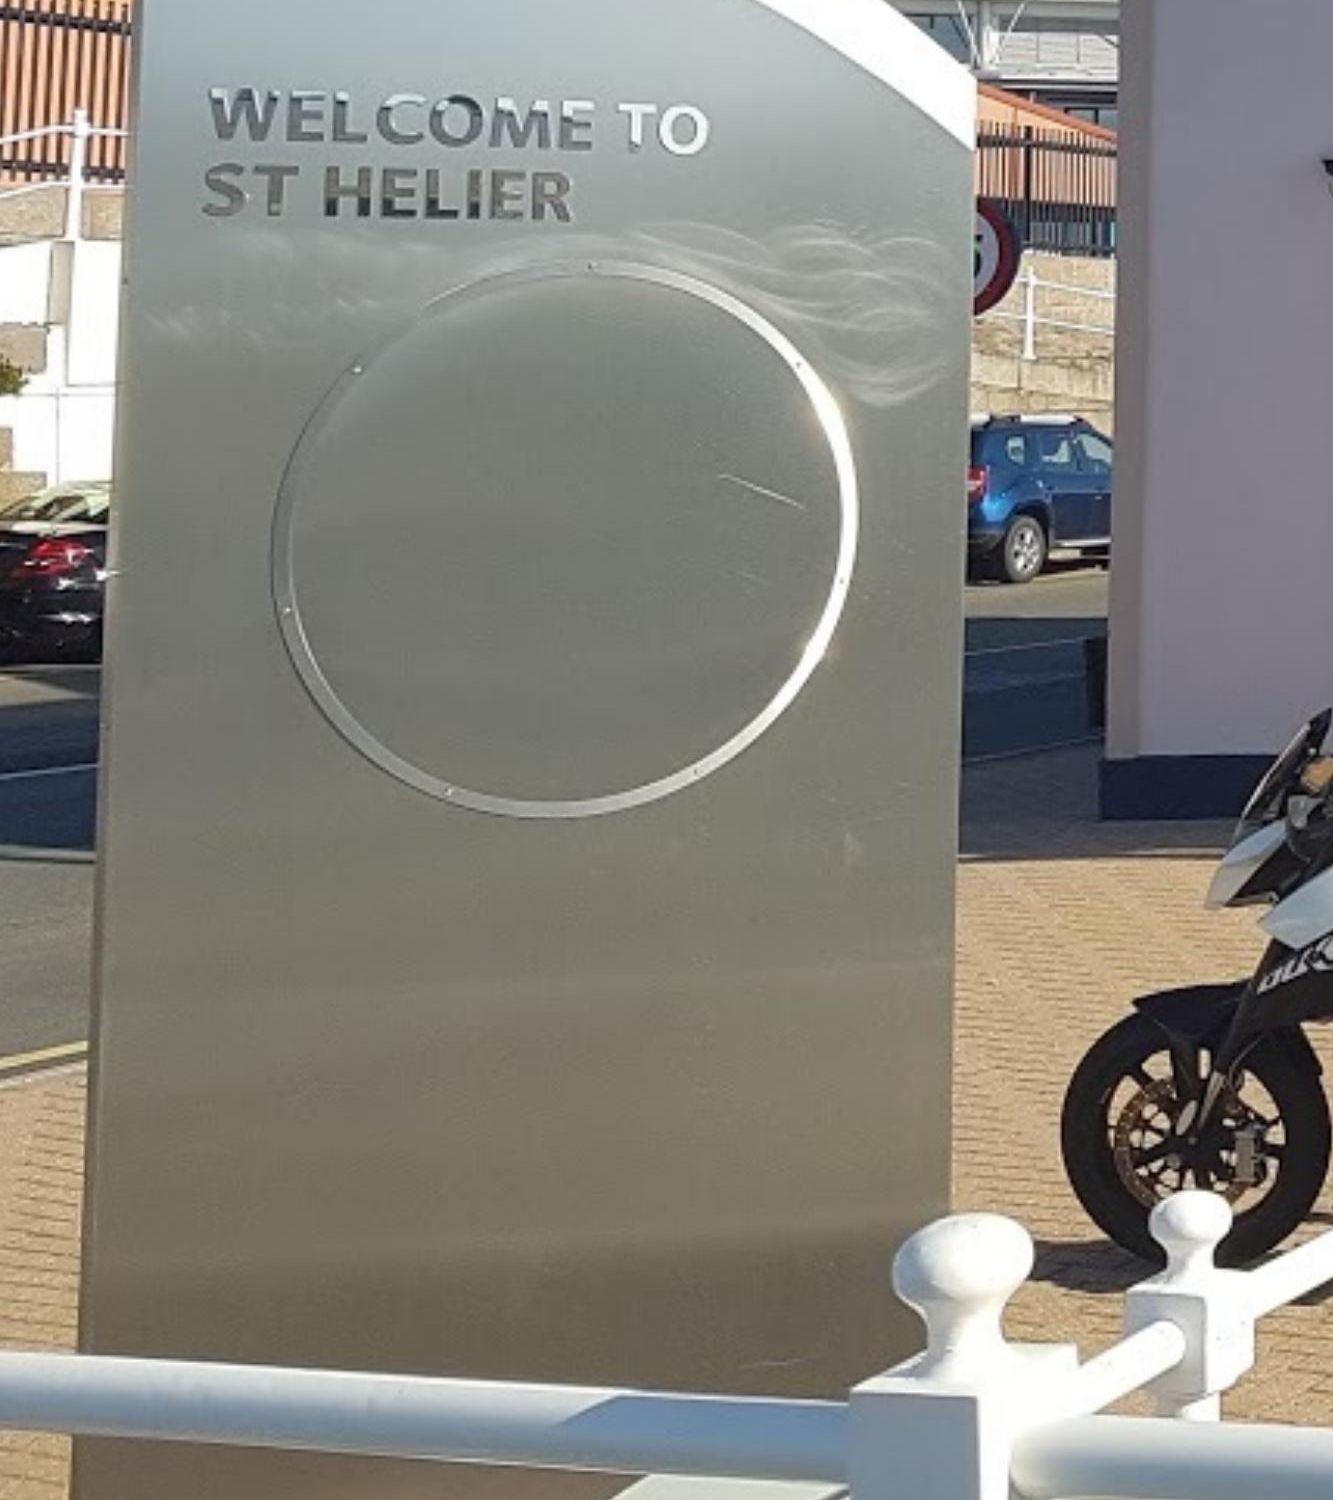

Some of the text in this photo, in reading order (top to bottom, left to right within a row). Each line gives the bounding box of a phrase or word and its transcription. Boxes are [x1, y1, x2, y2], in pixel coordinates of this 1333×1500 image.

[208, 86, 711, 156] WELCOME TO
[201, 162, 574, 223] ST HELIER
